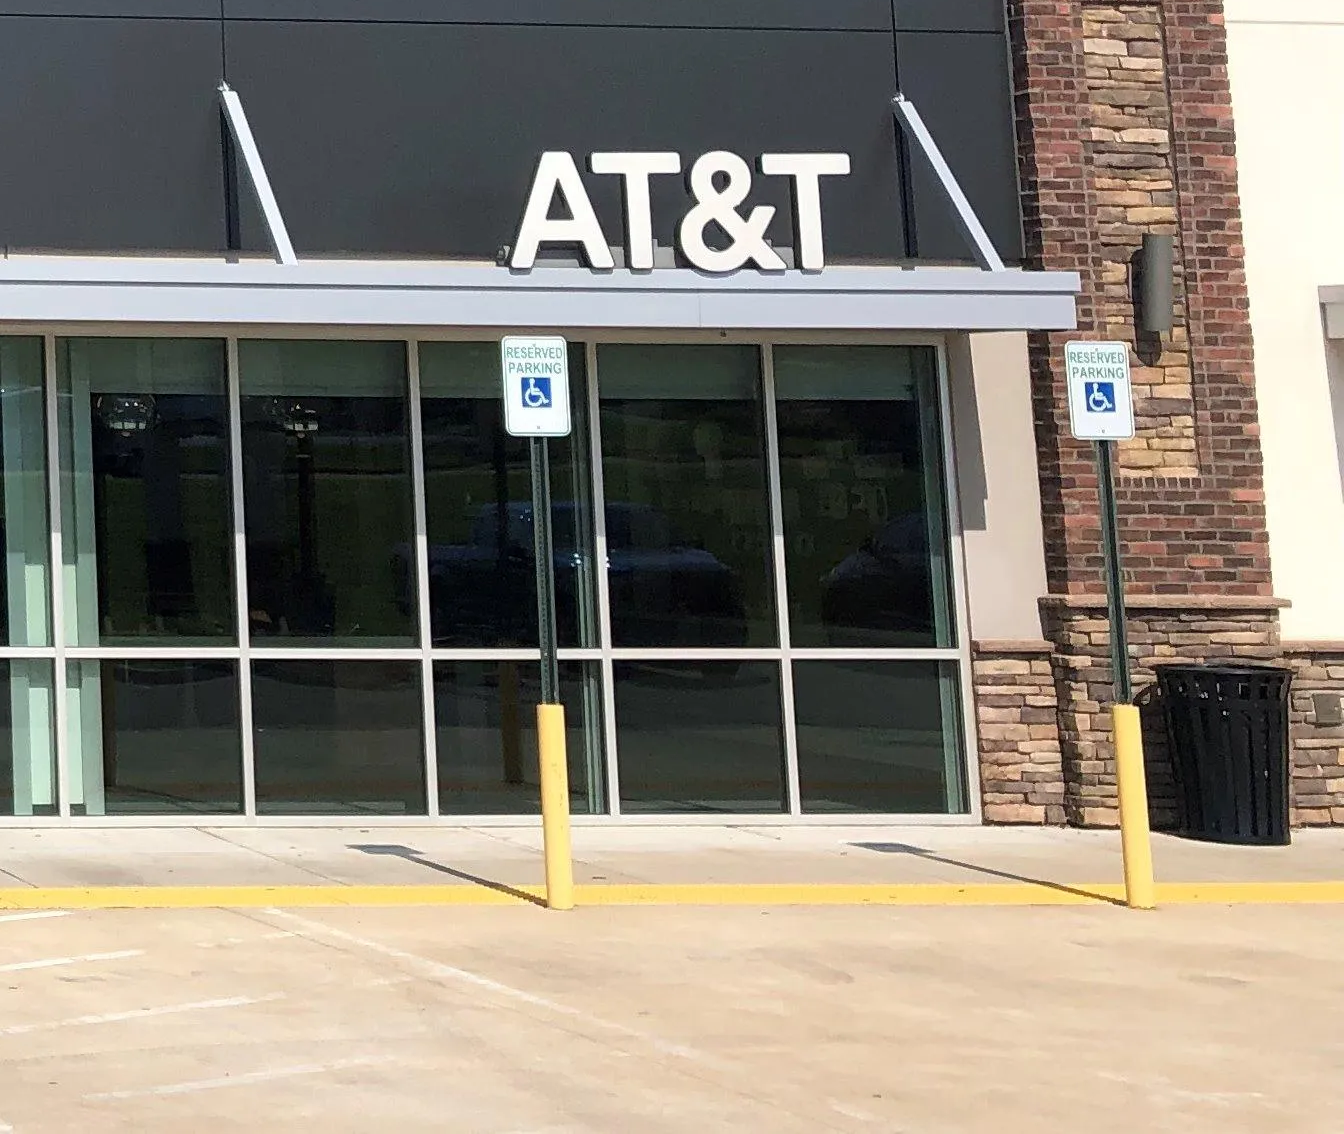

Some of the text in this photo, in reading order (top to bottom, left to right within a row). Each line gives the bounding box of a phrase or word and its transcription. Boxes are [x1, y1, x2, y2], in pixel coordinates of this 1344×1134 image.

[510, 150, 852, 272] AT&T
[506, 346, 563, 359] RESERVED
[1069, 351, 1125, 364] RESERVED
[508, 361, 562, 374] PARKING
[1072, 366, 1125, 379] PARKING
